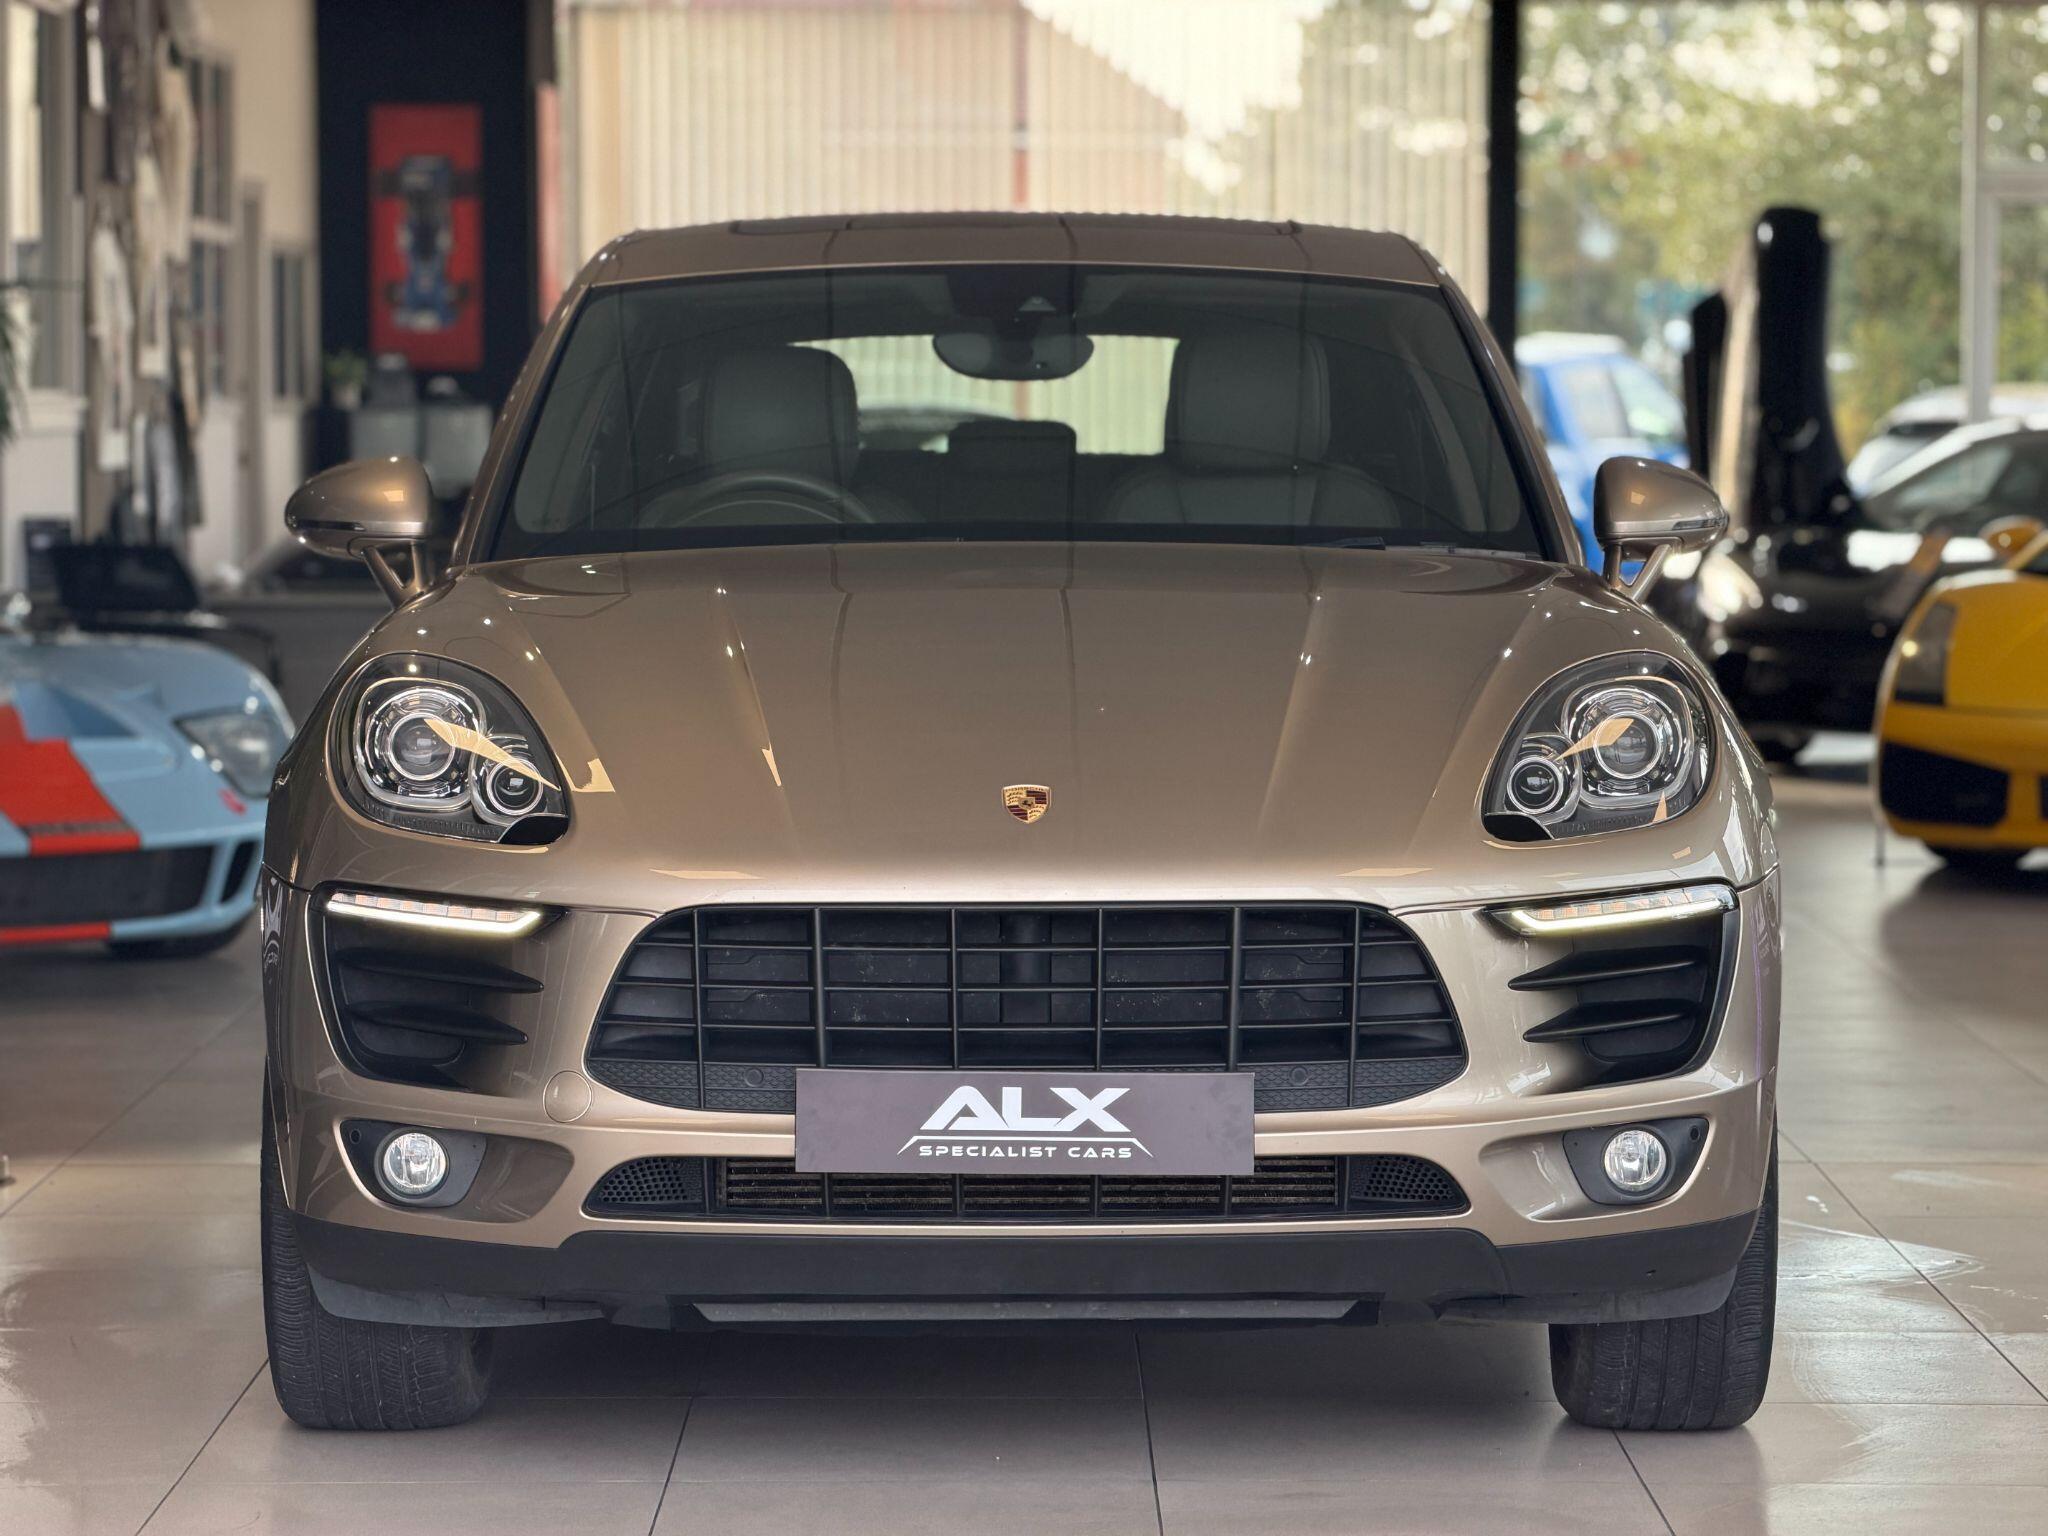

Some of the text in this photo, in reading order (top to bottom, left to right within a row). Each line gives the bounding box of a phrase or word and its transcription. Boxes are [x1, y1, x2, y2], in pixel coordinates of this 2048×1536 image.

[919, 1085, 1131, 1132] ALX
[919, 1145, 1132, 1159] SPECIALIST CARS
